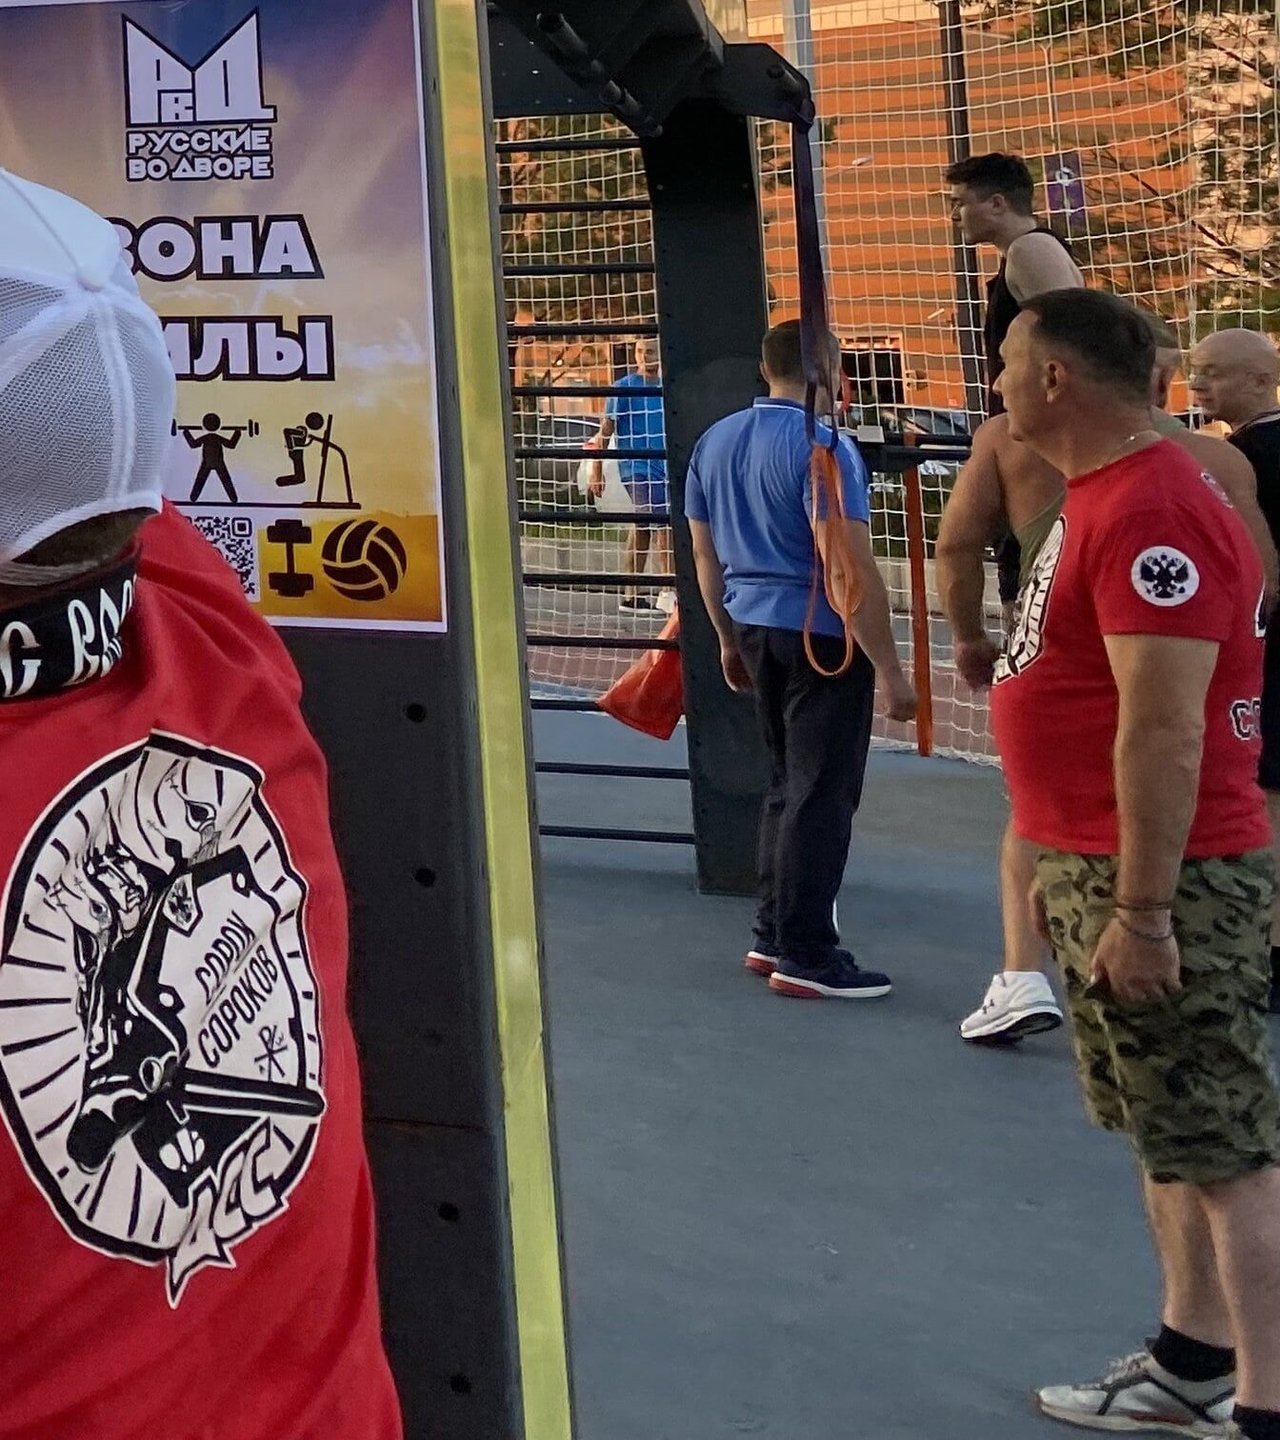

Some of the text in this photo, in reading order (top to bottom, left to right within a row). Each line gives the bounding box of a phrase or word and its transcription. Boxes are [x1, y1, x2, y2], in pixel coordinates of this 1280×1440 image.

[127, 126, 272, 155] РУССКИЕ
[127, 155, 272, 180] ВО ДВОРЕ
[197, 944, 279, 1069] СОРОКОВ
